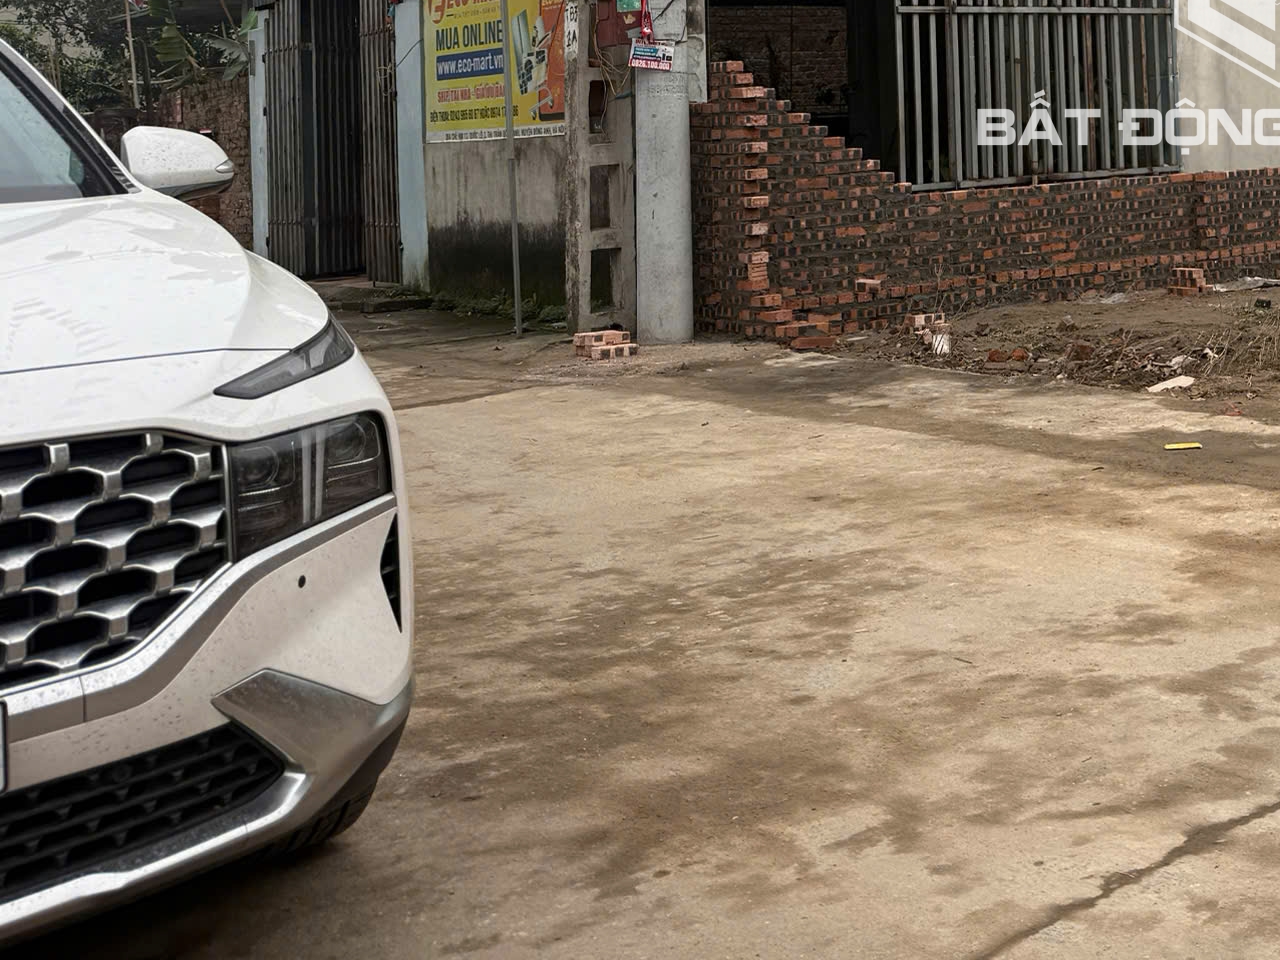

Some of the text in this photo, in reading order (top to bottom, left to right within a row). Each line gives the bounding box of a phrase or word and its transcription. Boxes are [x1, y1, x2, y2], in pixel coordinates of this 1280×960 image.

[435, 20, 503, 51] MUA ONLINE
[437, 53, 504, 75] www.eco-mart.vn
